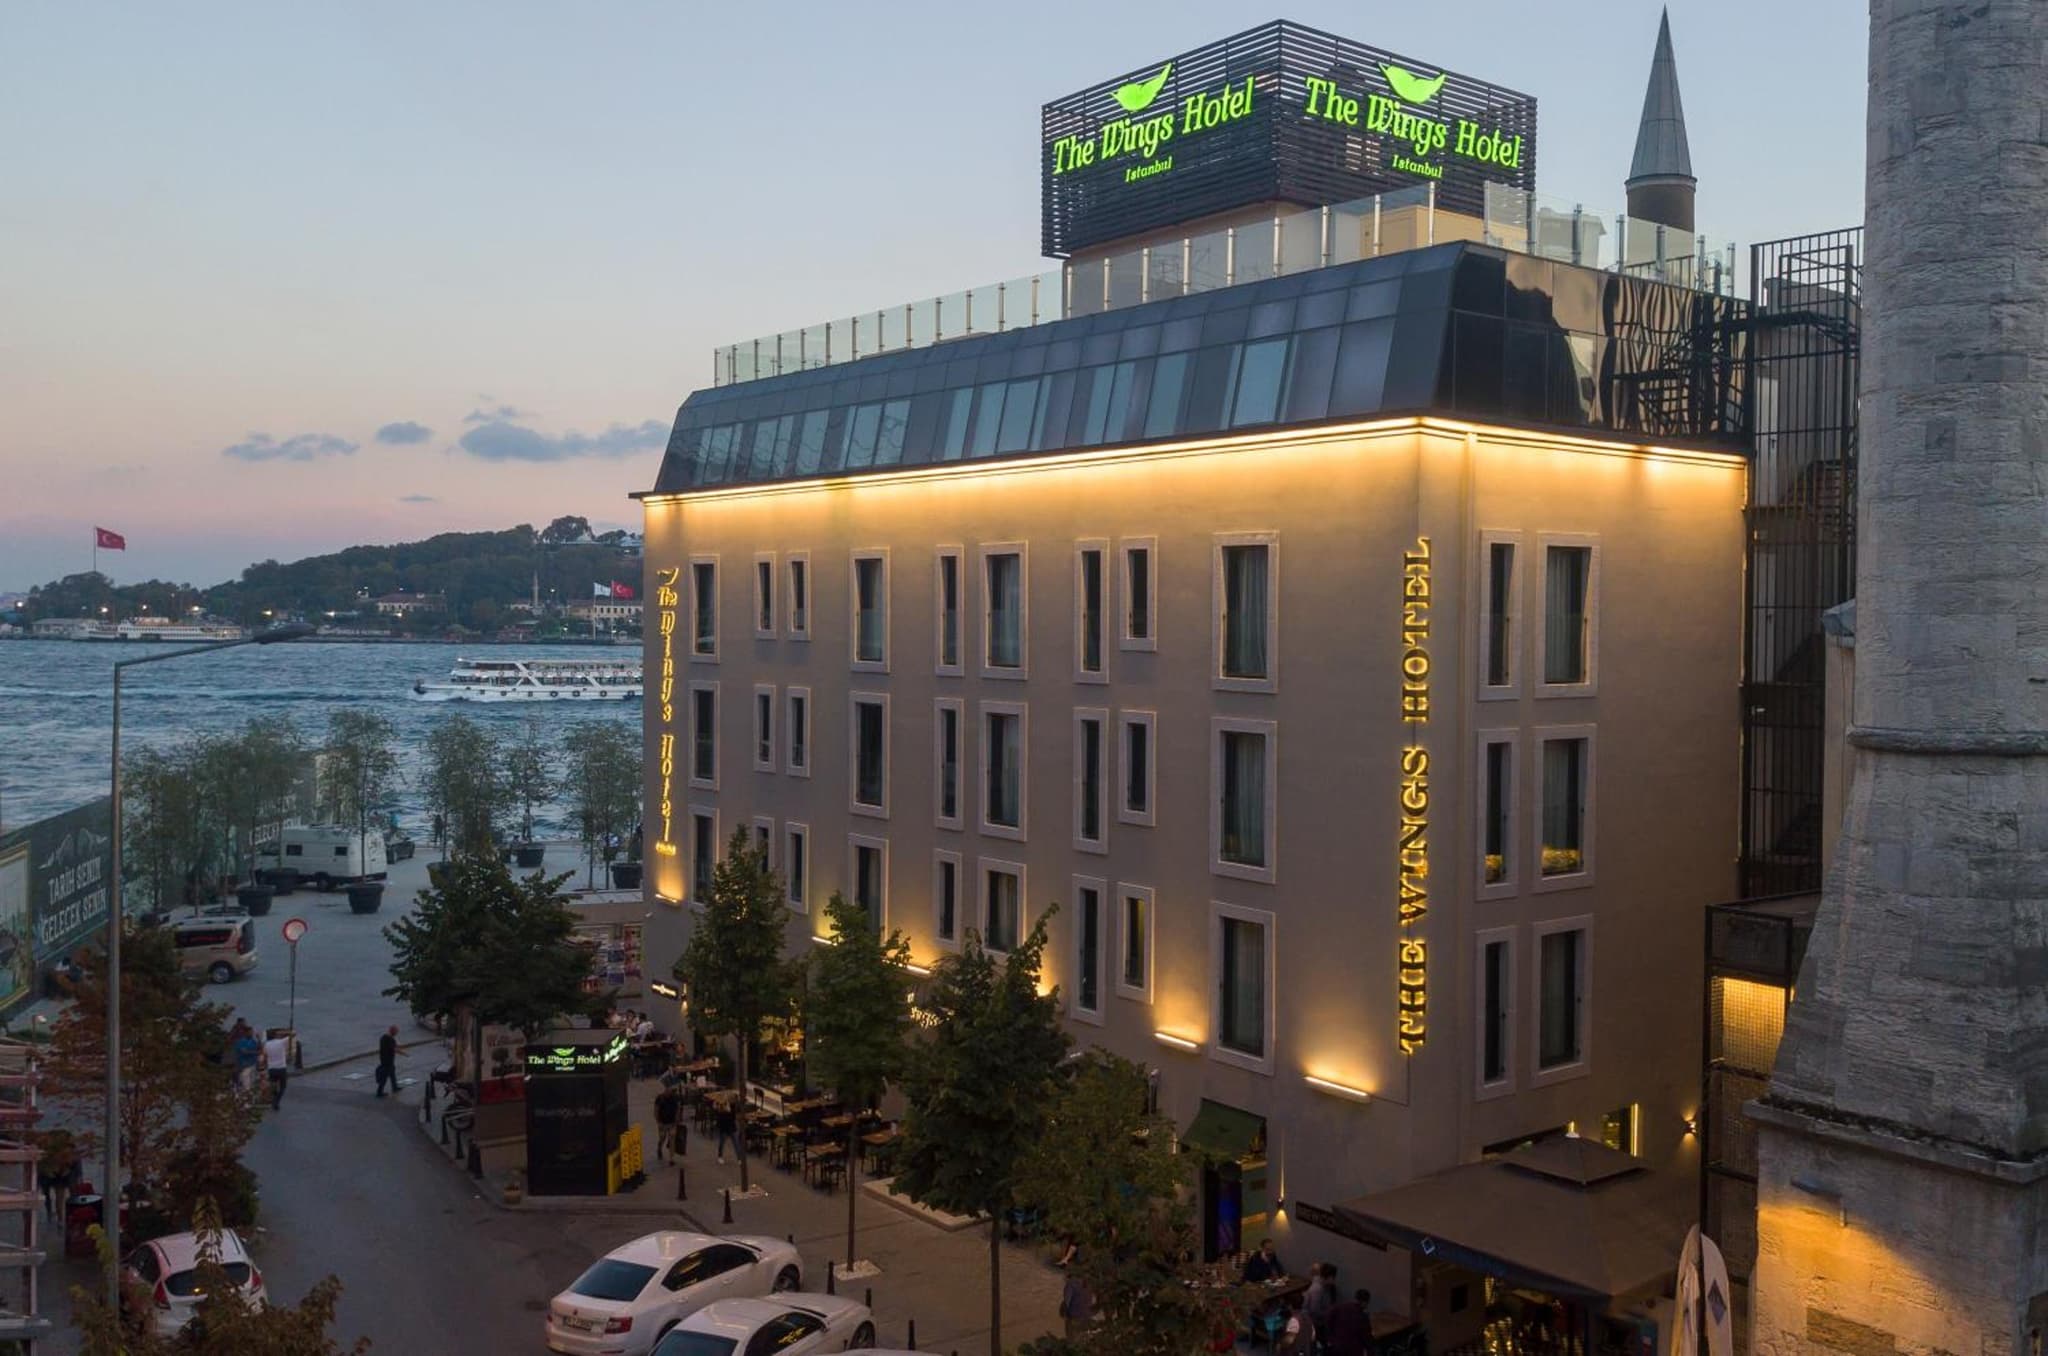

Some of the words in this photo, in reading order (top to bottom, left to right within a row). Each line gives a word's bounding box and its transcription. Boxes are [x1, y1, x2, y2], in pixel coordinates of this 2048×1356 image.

[1053, 135, 1095, 175] The
[1101, 113, 1175, 158] Wings
[1182, 76, 1255, 134] Hotel
[1125, 156, 1173, 182] Istanbul
[1306, 76, 1358, 125] The
[1367, 94, 1447, 155] Wings
[1455, 119, 1521, 168] Hotel
[1392, 154, 1443, 179] Istanbul
[660, 610, 676, 722] Wings
[1402, 536, 1432, 724] HOTEL
[661, 733, 675, 842] Hotel
[1399, 746, 1431, 926] WINGS
[42, 900, 82, 945] GELECEK
[1399, 942, 1427, 1056] THE
[528, 1055, 545, 1065] The
[547, 1055, 575, 1067] Wings
[576, 1055, 602, 1065] Hotel
